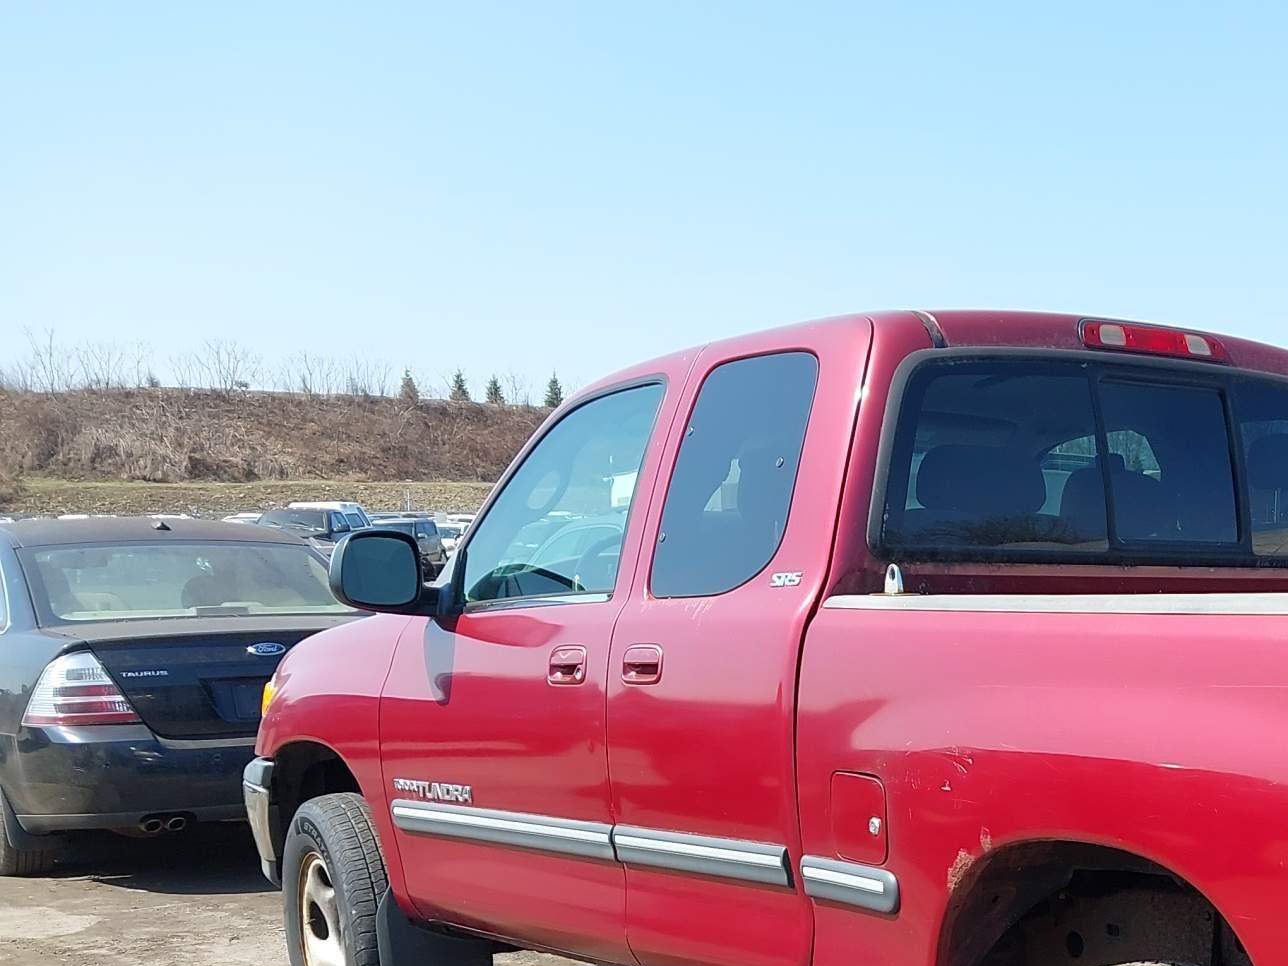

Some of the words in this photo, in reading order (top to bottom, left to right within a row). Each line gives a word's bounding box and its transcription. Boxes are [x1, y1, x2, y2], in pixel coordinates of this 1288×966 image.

[770, 572, 803, 588] SR5
[120, 670, 169, 678] TAURUS
[416, 781, 473, 803] TUNDRA
